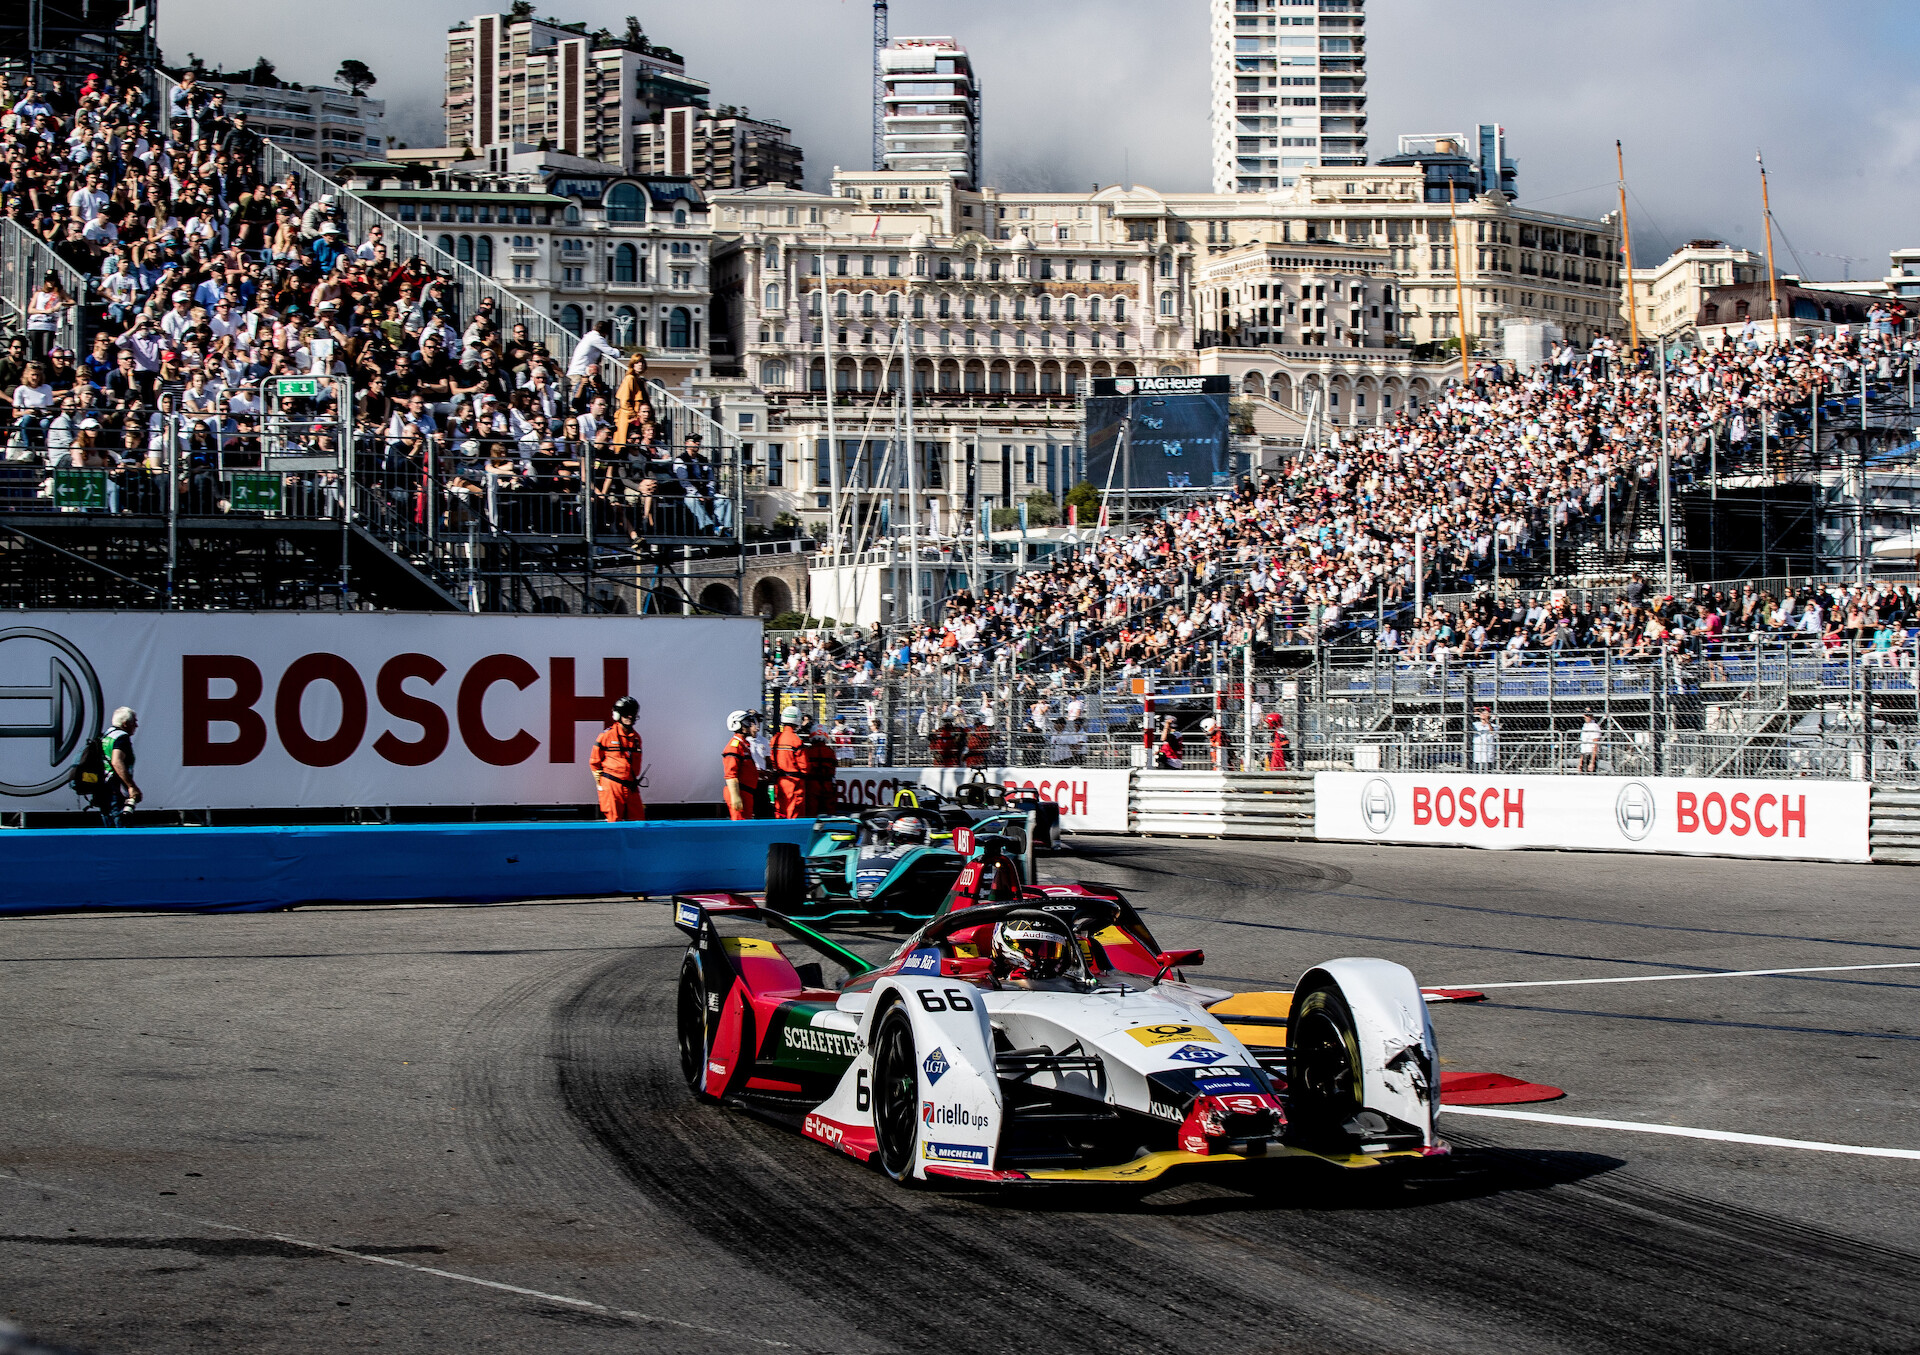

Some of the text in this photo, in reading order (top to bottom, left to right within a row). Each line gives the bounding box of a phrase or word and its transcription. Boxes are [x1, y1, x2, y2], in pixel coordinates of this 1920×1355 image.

[182, 652, 629, 767] BOSCH
[835, 779, 906, 806] BOSC
[1413, 786, 1525, 829] BOSCH
[1677, 791, 1806, 838] BOSCH
[957, 829, 970, 853] ABT
[1022, 931, 1044, 939] Audi
[901, 954, 936, 970] Julius Bär
[916, 988, 974, 1012] 66
[1175, 1050, 1220, 1060] LGT
[926, 1061, 946, 1073] LGT
[1194, 1067, 1241, 1079] ABB
[1204, 1082, 1232, 1091] Julius
[937, 1104, 989, 1130] riello ups
[1150, 1101, 1185, 1123] KUKA
[805, 1116, 843, 1142] e-tron
[938, 1149, 983, 1159] MICHELIN
